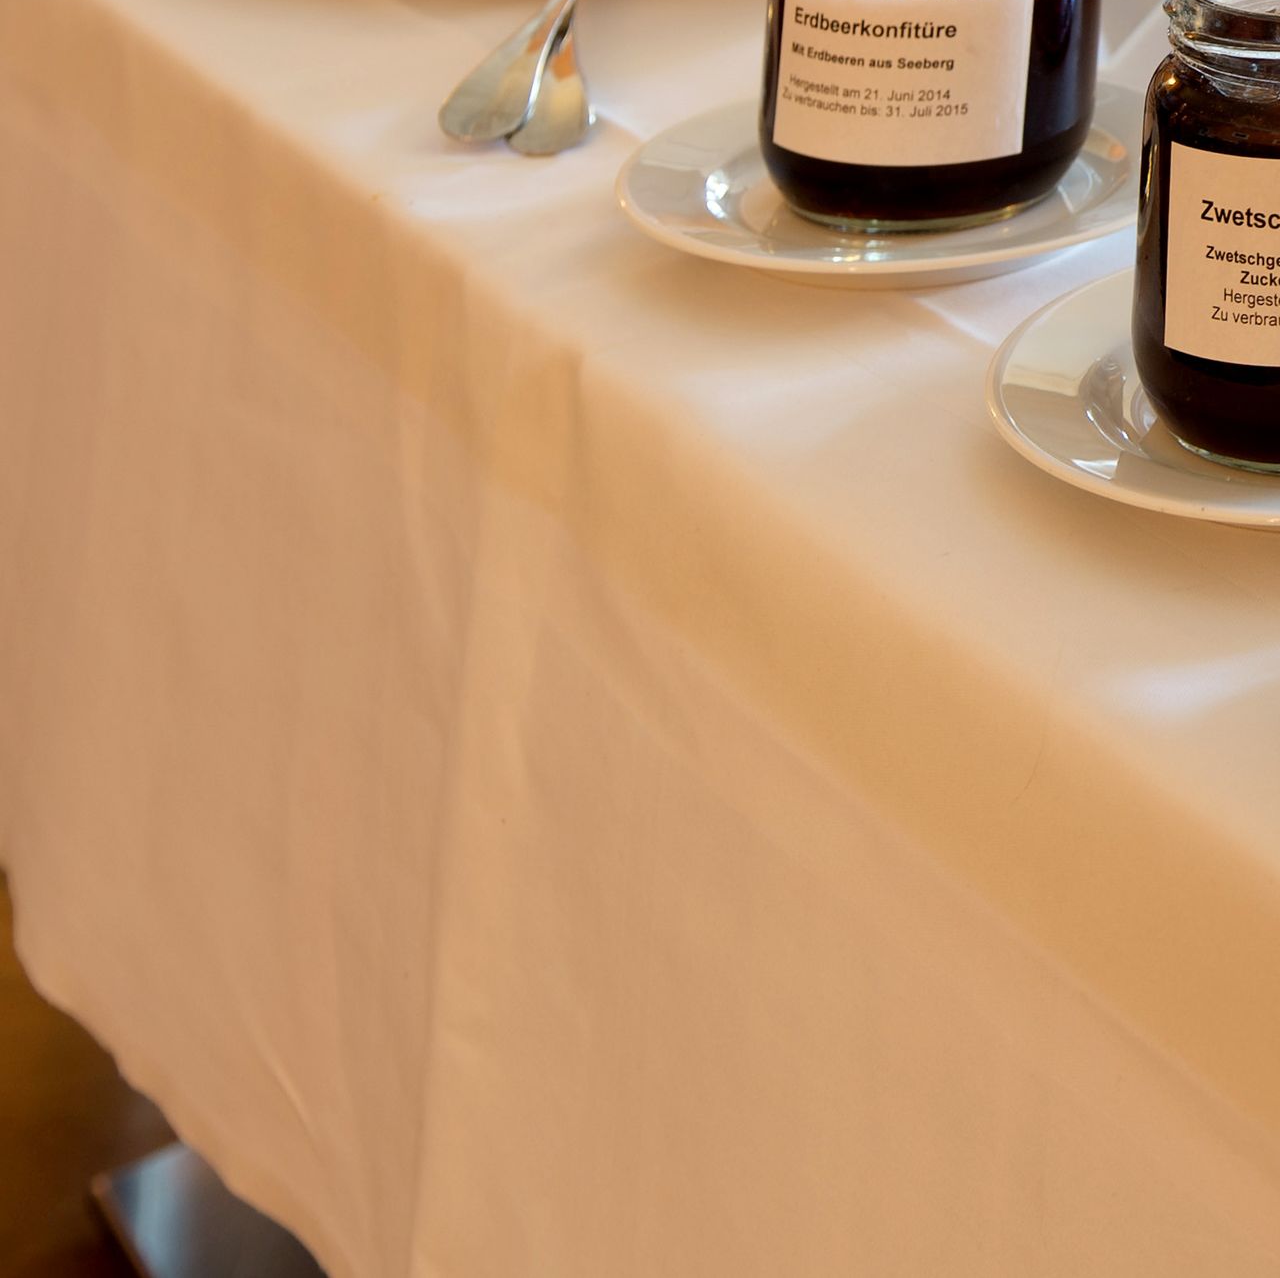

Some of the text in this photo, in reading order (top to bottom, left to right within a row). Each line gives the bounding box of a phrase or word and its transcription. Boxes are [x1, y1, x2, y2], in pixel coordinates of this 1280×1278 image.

[794, 6, 958, 40] Erdbeerkonfitüre
[791, 42, 955, 71] Mit Erdbeeren aus Seeberg
[789, 73, 951, 102] Hergestellt am 21. Juni 2014
[782, 87, 968, 118] Zu verbrauchen bis: 31. Juli 2015
[1211, 306, 1228, 322] Zu
